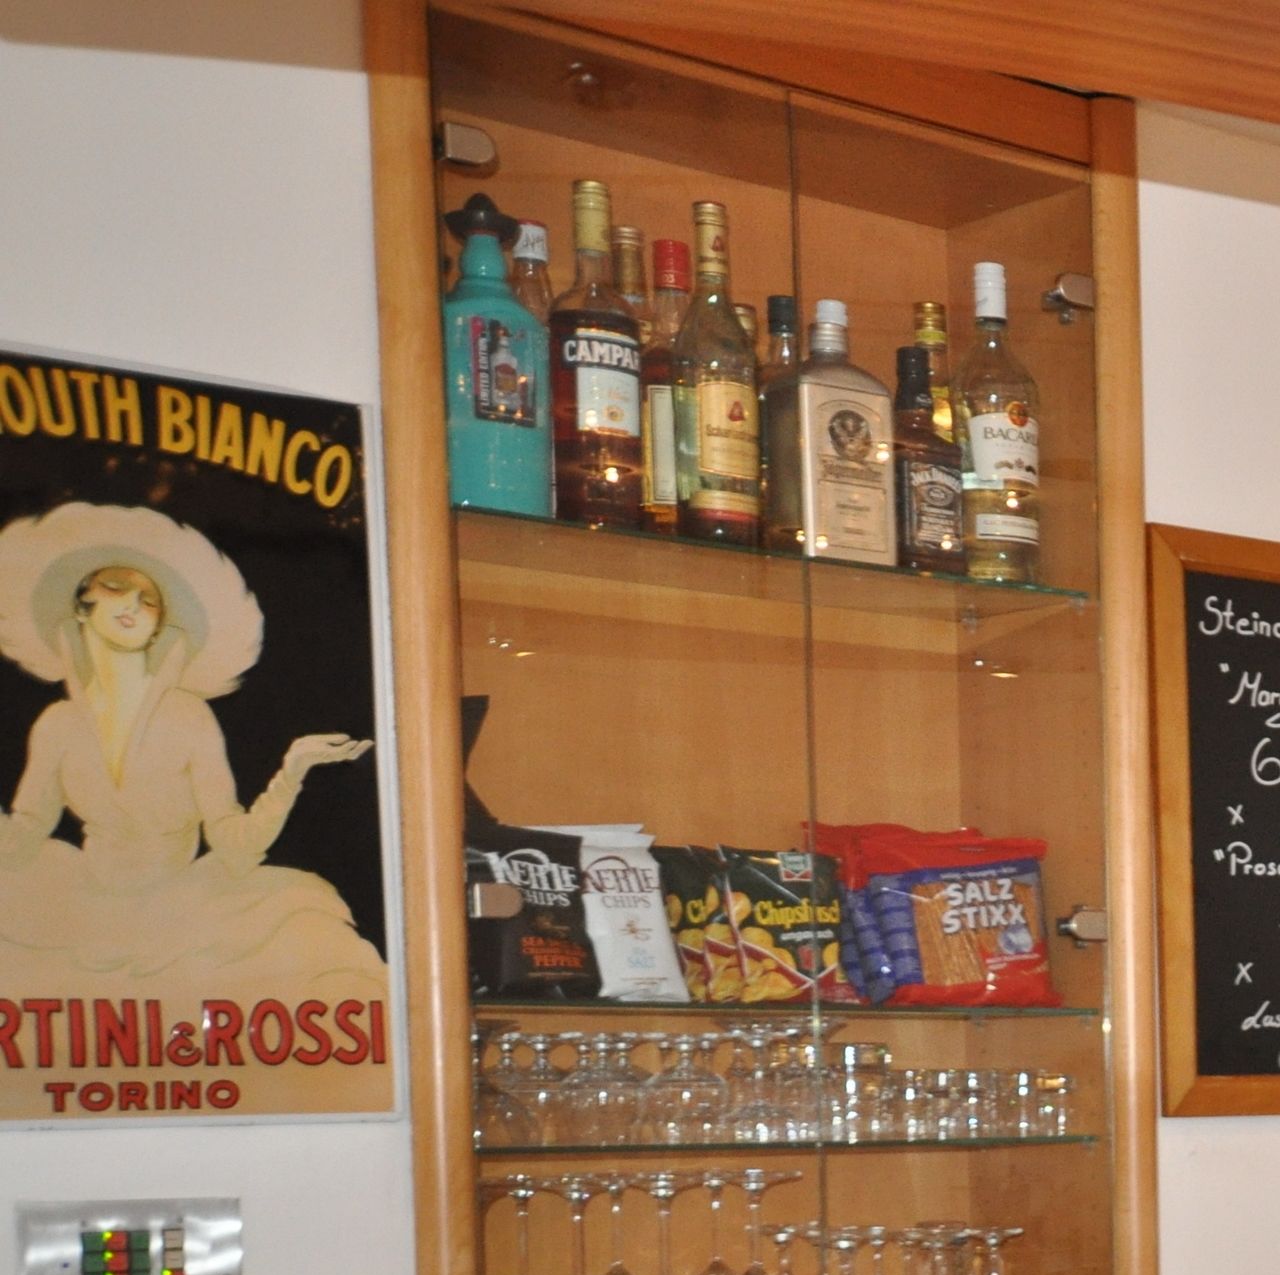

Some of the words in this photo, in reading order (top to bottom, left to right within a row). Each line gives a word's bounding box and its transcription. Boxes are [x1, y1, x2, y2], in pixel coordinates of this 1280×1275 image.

[0, 363, 144, 446] OUTH
[157, 384, 353, 509] BIANCO
[484, 848, 581, 892] KETTLE
[580, 855, 662, 894] KETTLE
[601, 895, 651, 909] CHIPS
[947, 878, 1015, 907] SALZ
[941, 903, 1027, 934] STIXX
[45, 1079, 241, 1112] TORINO
